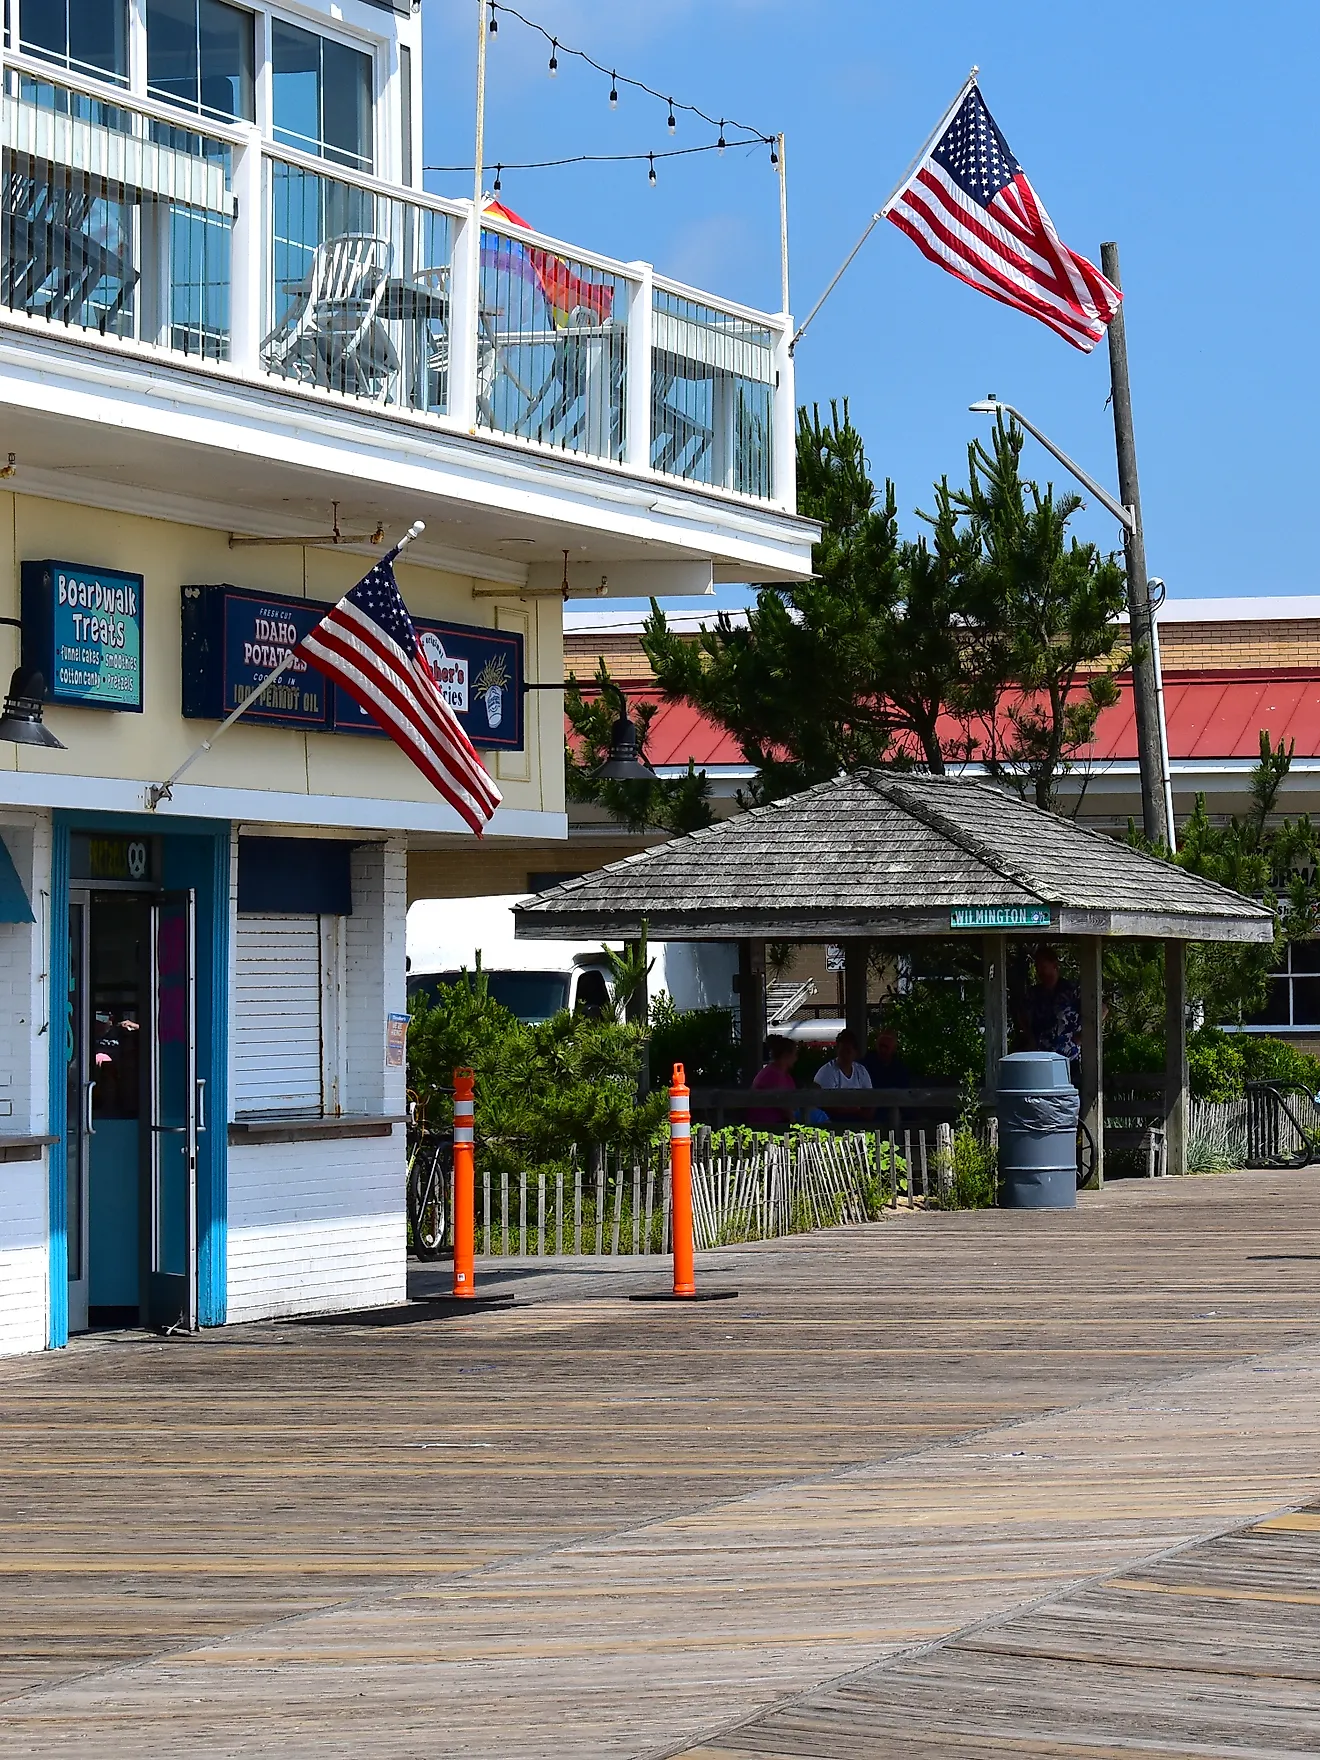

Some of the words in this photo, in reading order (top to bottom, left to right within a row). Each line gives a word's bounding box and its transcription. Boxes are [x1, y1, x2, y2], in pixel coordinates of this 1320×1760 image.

[259, 607, 278, 618] FRESH
[280, 612, 292, 620] CUT
[72, 613, 125, 648] Treats
[255, 618, 297, 644] IDAHO
[287, 677, 296, 686] IN
[303, 692, 319, 713] OIL
[955, 908, 1027, 925] WILMINGTON
